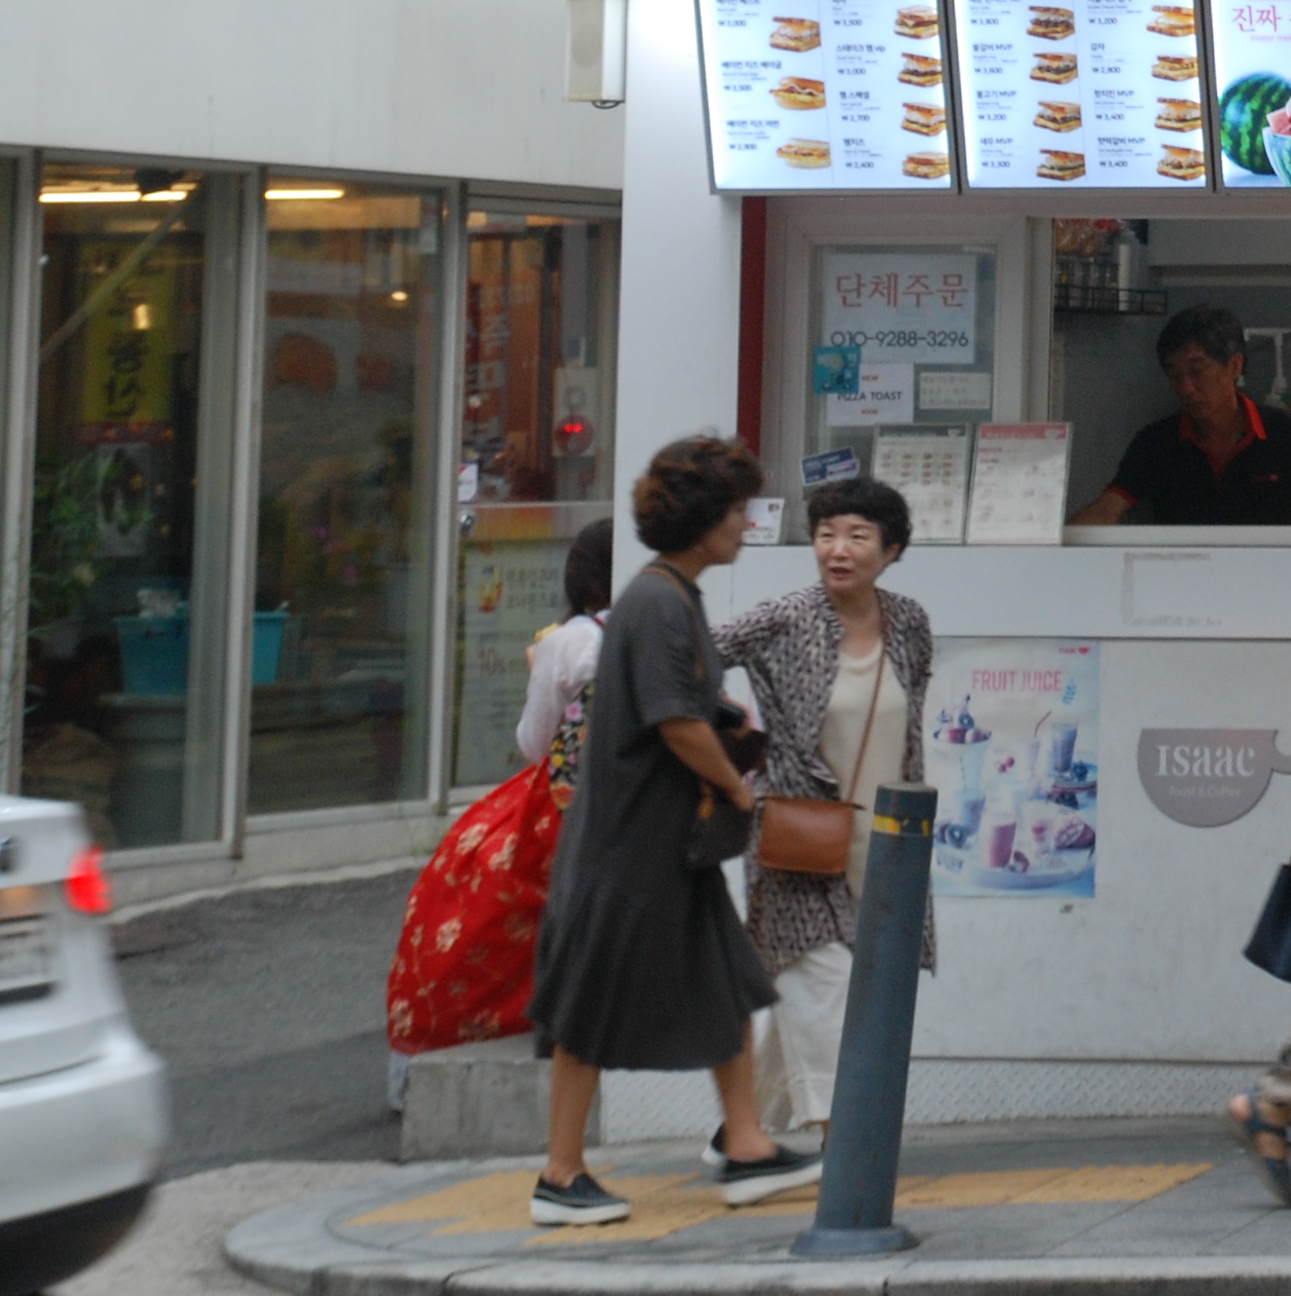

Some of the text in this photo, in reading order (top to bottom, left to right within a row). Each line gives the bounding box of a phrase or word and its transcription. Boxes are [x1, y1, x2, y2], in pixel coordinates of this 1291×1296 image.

[1231, 4, 1282, 33] 진짜
[835, 272, 969, 309] 단체주문
[830, 330, 969, 349] 010-9288-3296
[870, 391, 902, 400] TOAST
[972, 670, 1063, 692] FRUIT JUICE
[1155, 744, 1256, 777] Isaac
